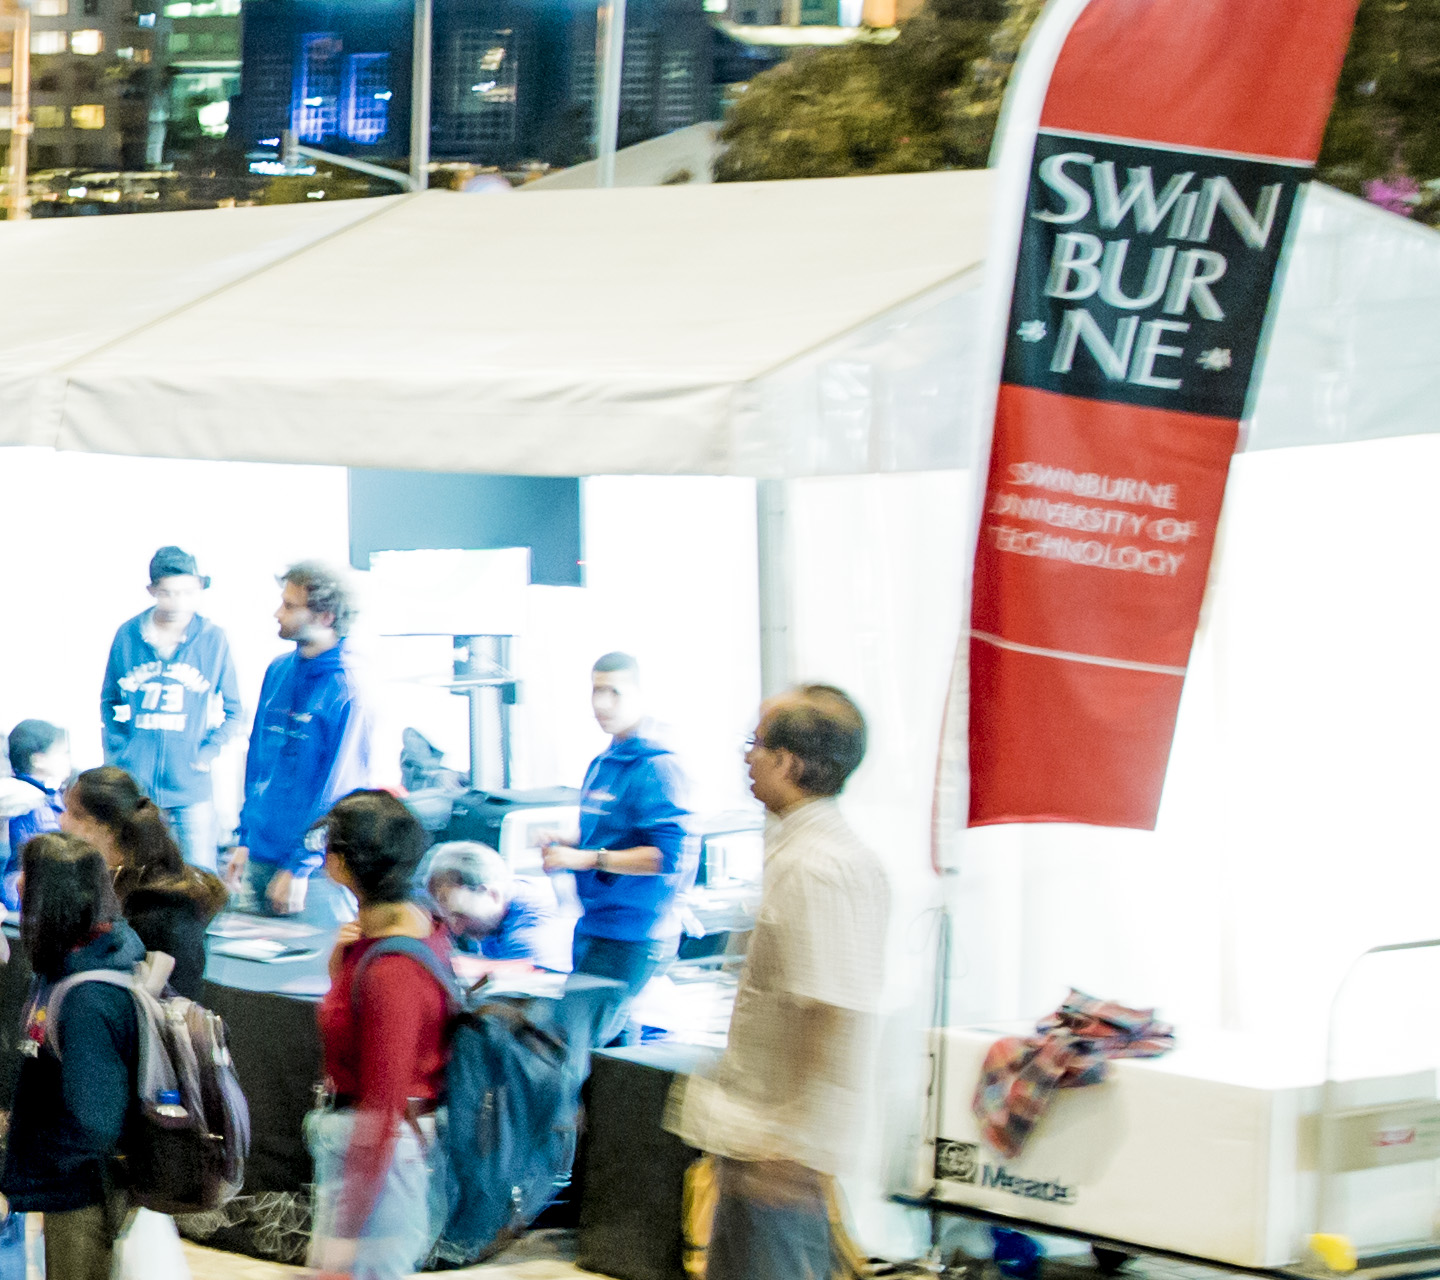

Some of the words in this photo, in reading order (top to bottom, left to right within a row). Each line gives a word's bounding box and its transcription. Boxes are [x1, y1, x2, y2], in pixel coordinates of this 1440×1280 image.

[1030, 152, 1283, 251] SWIN
[1043, 232, 1227, 321] BUR
[1050, 308, 1191, 389] NE
[1007, 461, 1177, 510] SWINBURNE
[989, 524, 1185, 577] TECHNOLOGY
[1146, 517, 1198, 545] OF
[140, 682, 184, 713] 73
